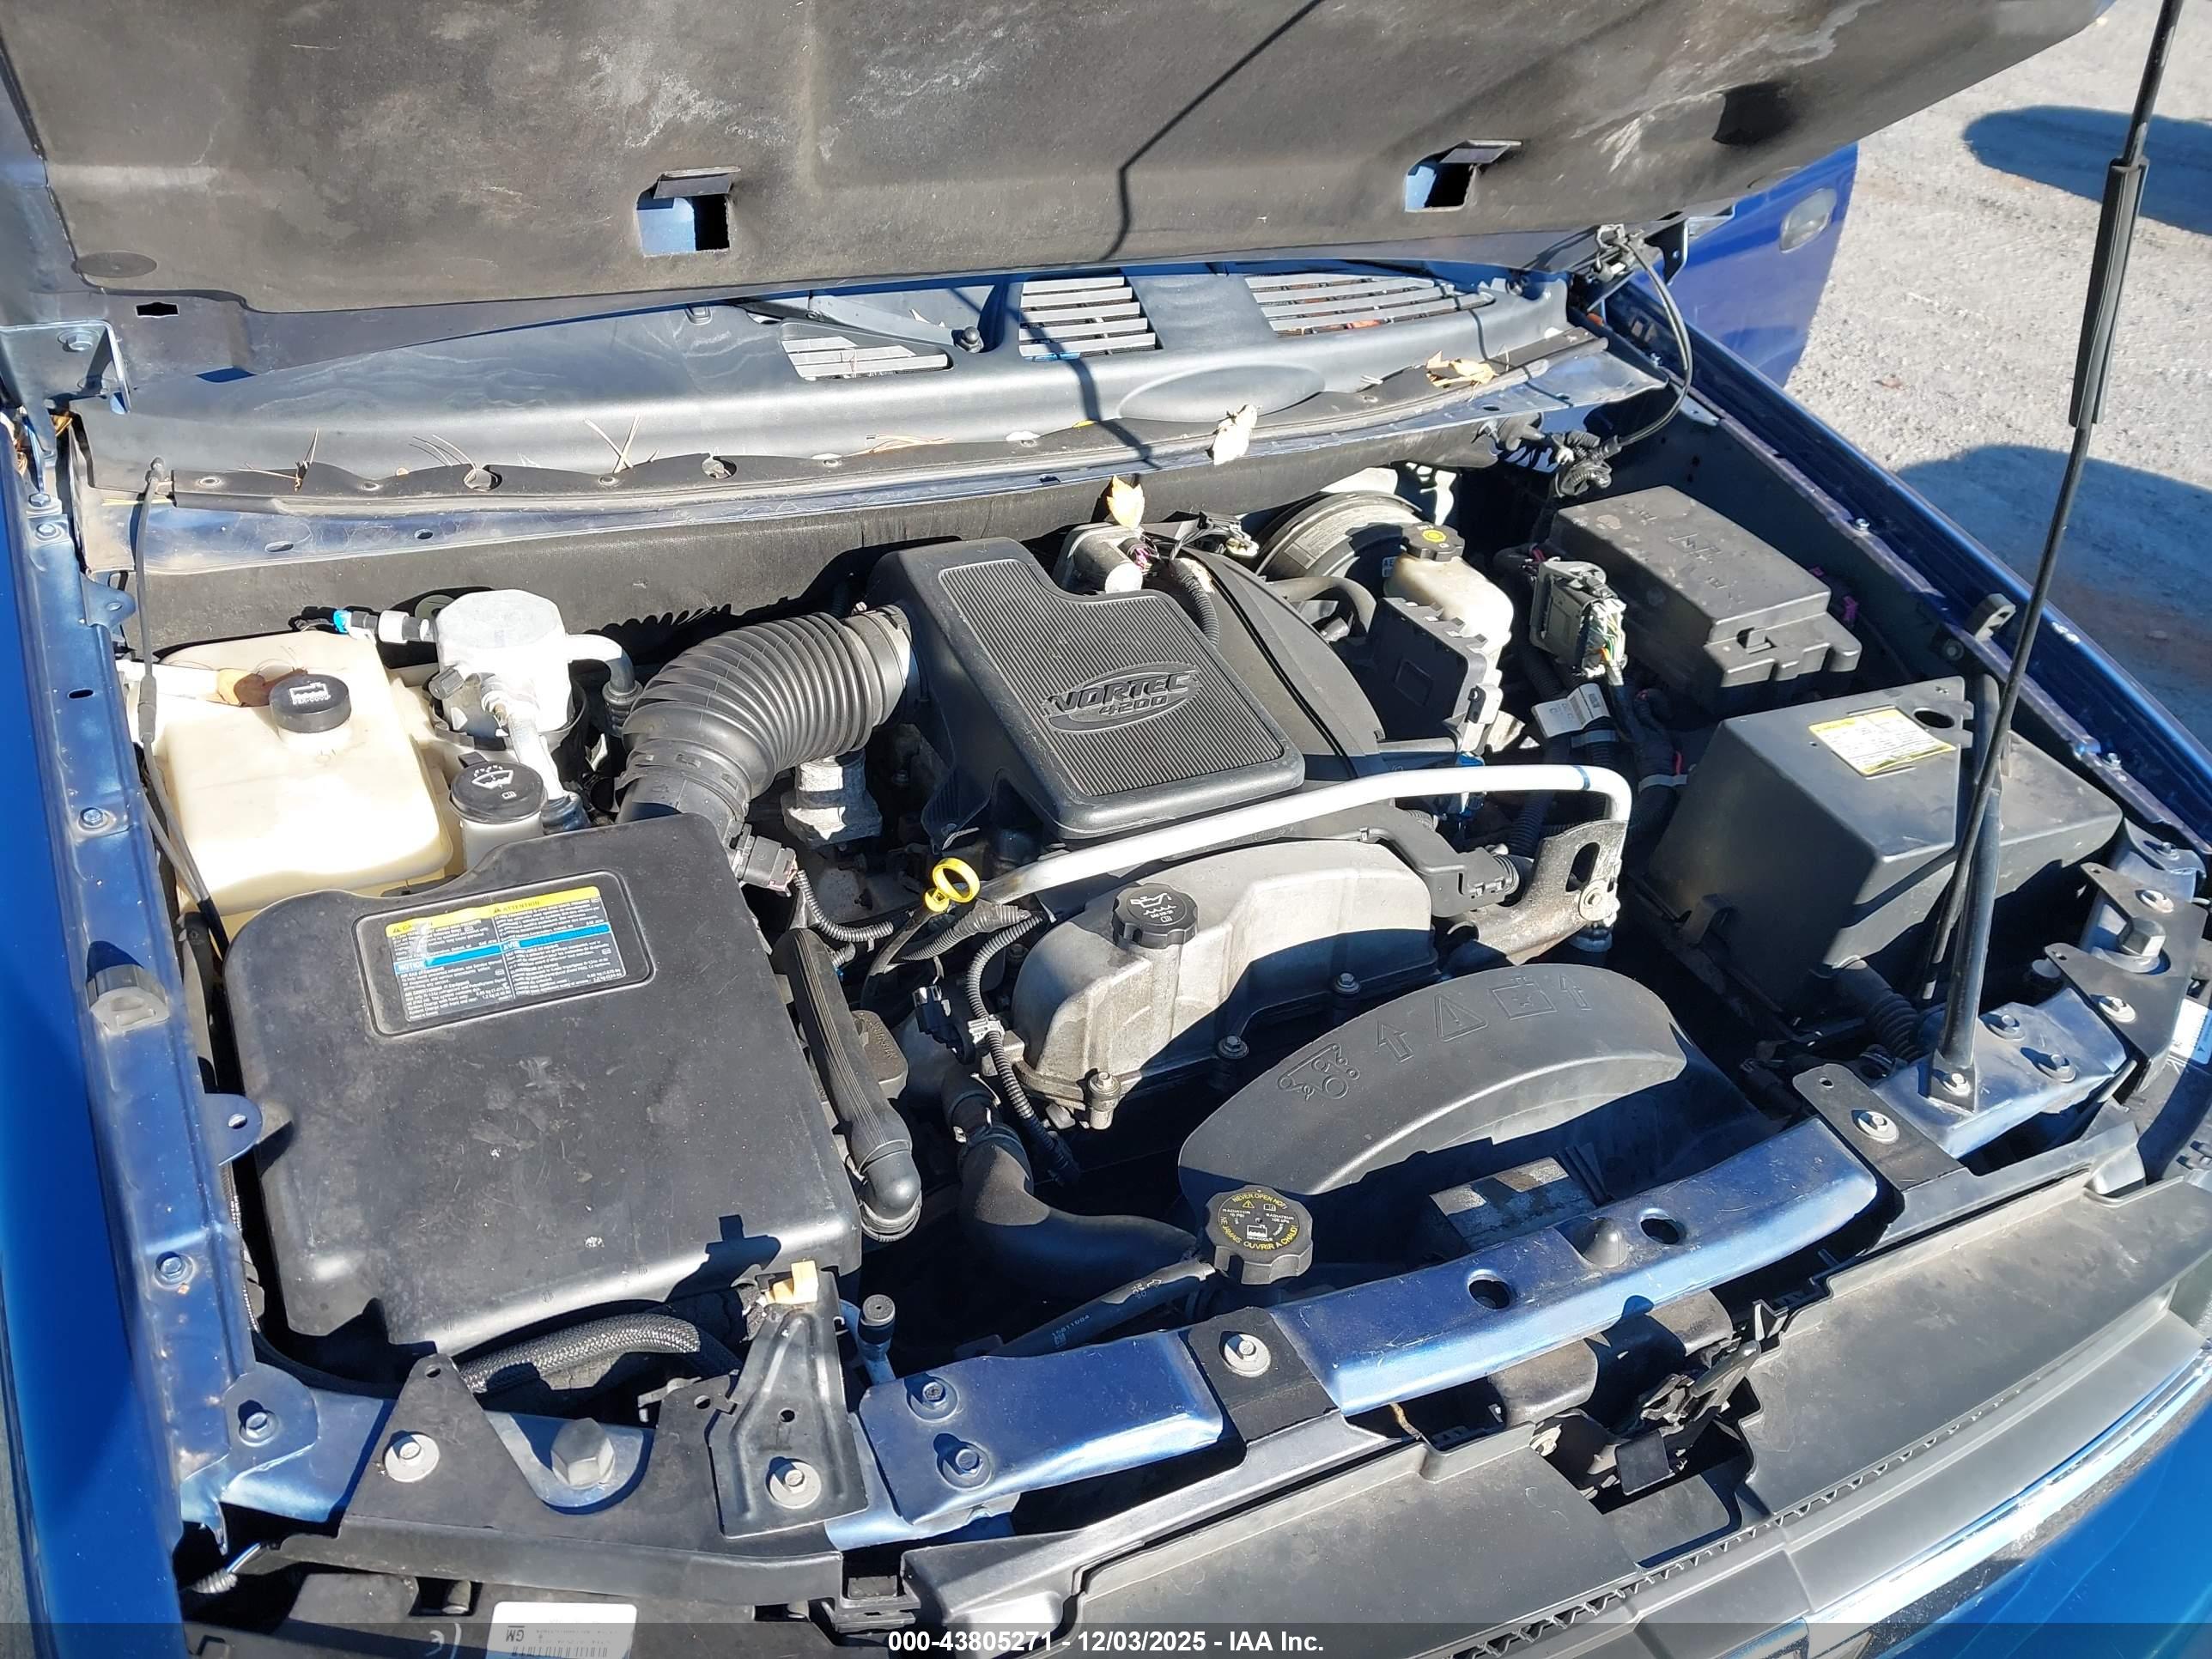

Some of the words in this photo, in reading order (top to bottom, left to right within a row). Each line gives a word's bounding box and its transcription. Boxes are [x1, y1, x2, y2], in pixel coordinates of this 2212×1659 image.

[1048, 673, 1191, 713] VORTEC
[1099, 696, 1168, 715] 4200
[503, 940, 520, 951] AVIS
[398, 959, 426, 972] NOTICE
[1232, 1193, 1255, 1203] NEVER
[1255, 1193, 1273, 1203] OPEN
[1222, 1225, 1243, 1243] JAMAIS
[1243, 1241, 1275, 1251] OUVRIR
[505, 1628, 526, 1642] GM
